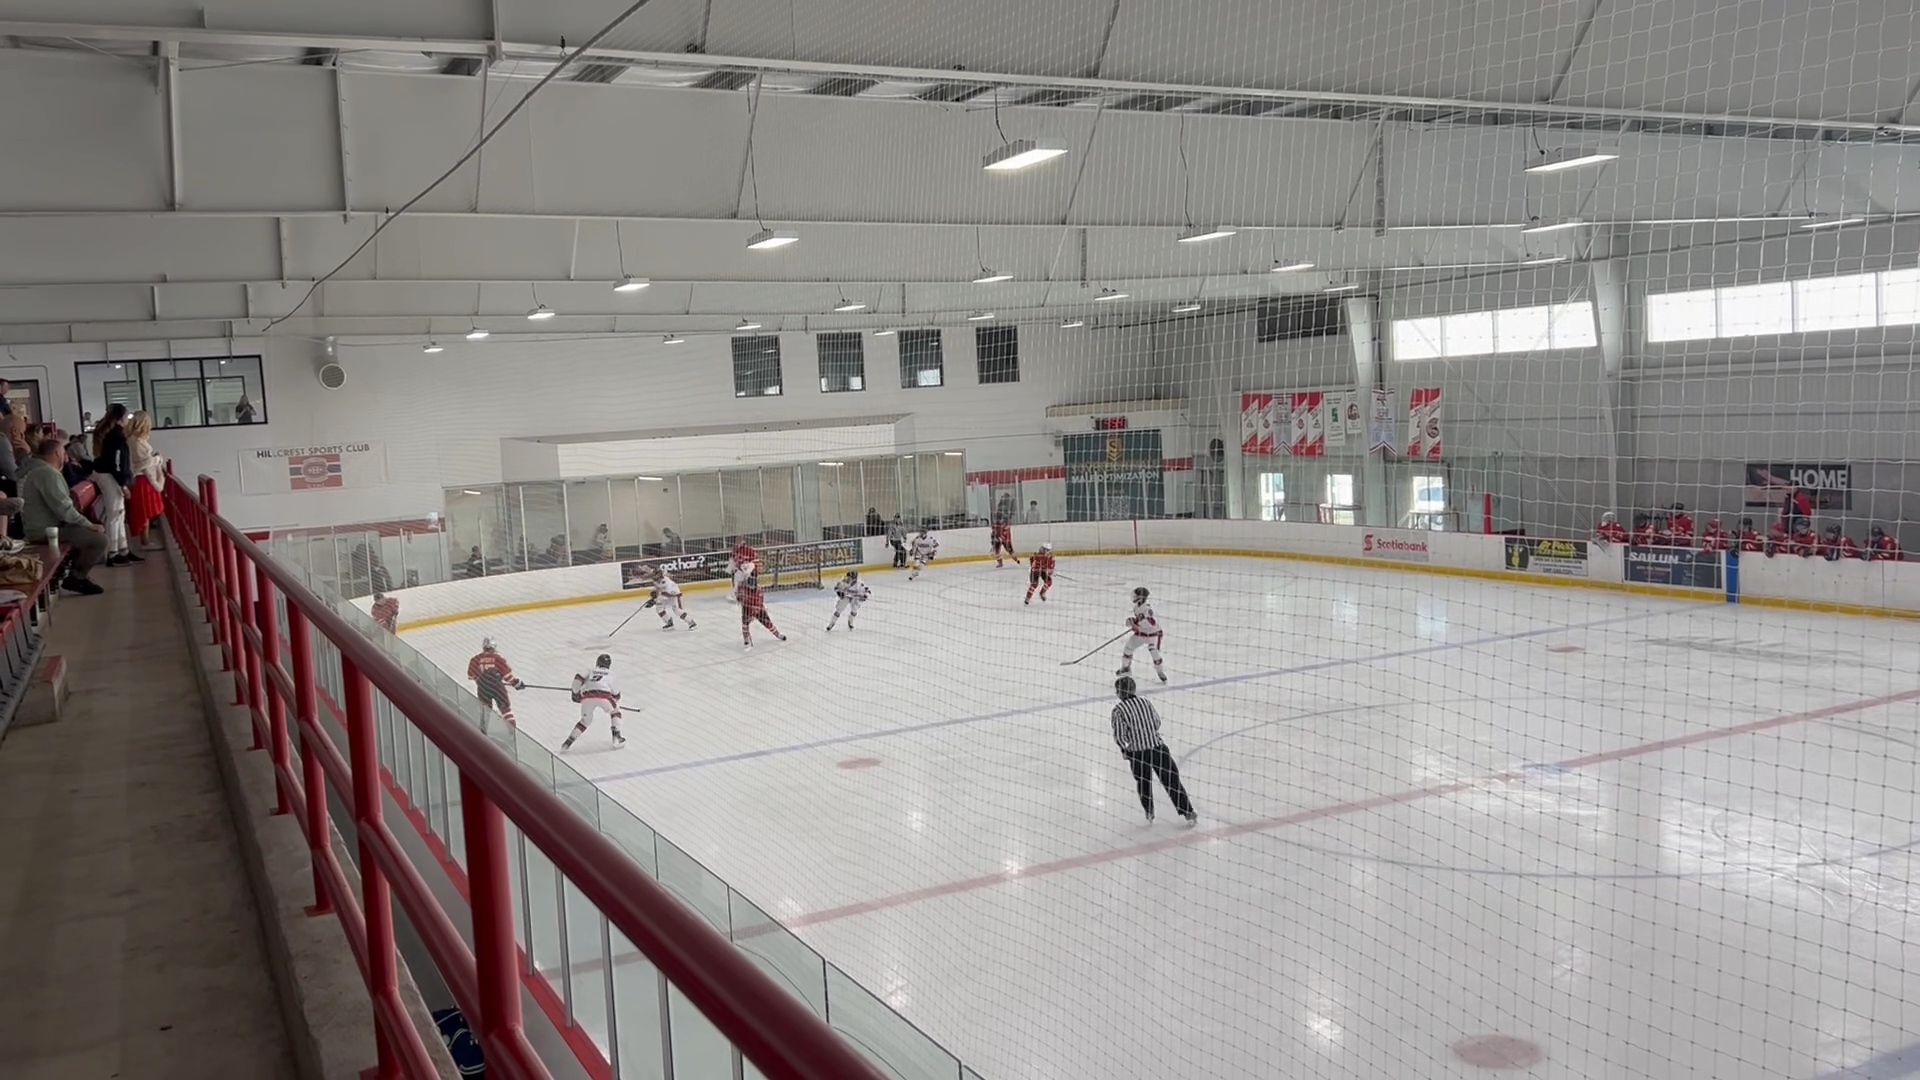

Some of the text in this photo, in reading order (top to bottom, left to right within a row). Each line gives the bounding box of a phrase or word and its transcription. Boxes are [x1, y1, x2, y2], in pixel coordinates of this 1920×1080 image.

[256, 443, 370, 458] HILLCREST SPORTS CLUB
[1790, 468, 1848, 489] HOME
[1376, 538, 1428, 552] Scotiabank
[827, 547, 856, 560] MALE
[1629, 551, 1679, 564] SAILUN
[659, 556, 705, 572] got hair?
